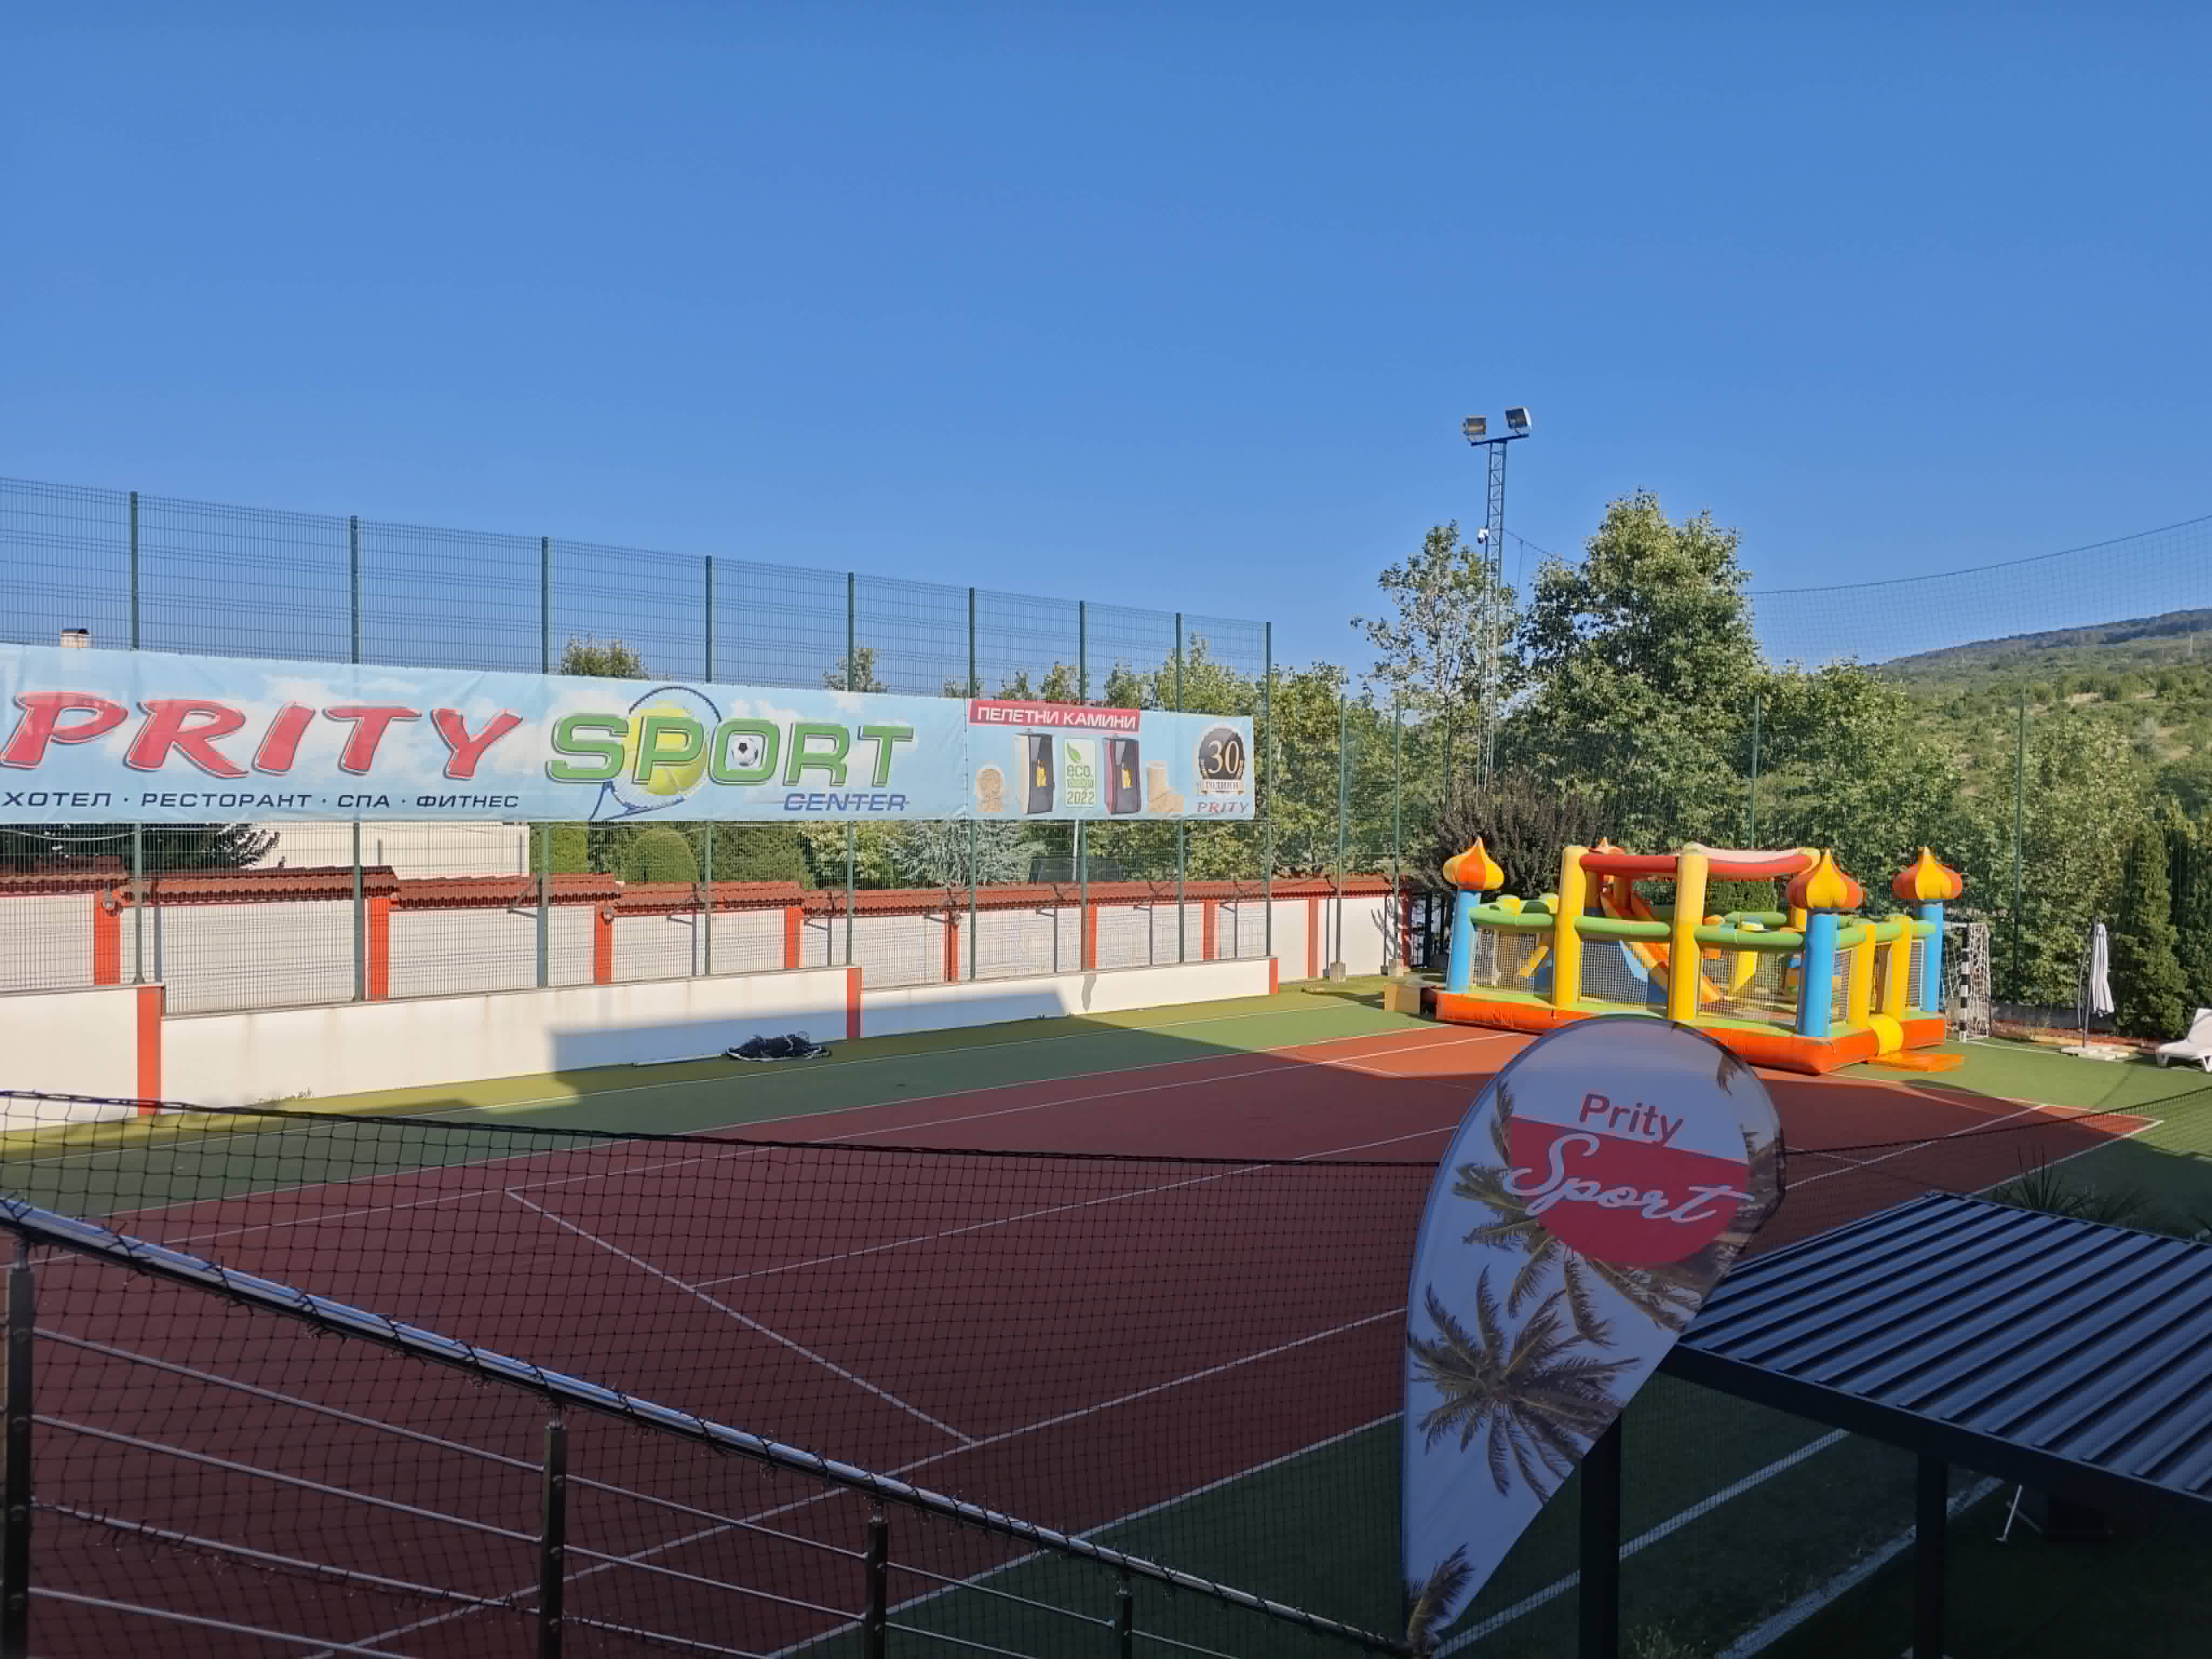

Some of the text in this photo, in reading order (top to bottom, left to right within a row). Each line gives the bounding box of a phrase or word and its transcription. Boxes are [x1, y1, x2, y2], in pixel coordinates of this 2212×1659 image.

[977, 706, 1136, 729] ПЕЛЕТНИ КАМИНИ
[0, 691, 914, 787] PRITY SPORT
[1208, 739, 1240, 774] 30
[2, 792, 520, 808] ХОТЕЛ РЕСТОРАНТ СПА ФИТНЕС
[784, 793, 907, 811] CENTER
[1068, 791, 1094, 804] 2022
[1196, 802, 1250, 814] PRITY
[1579, 1092, 1684, 1145] Prity
[1502, 1134, 1755, 1224] Sport
